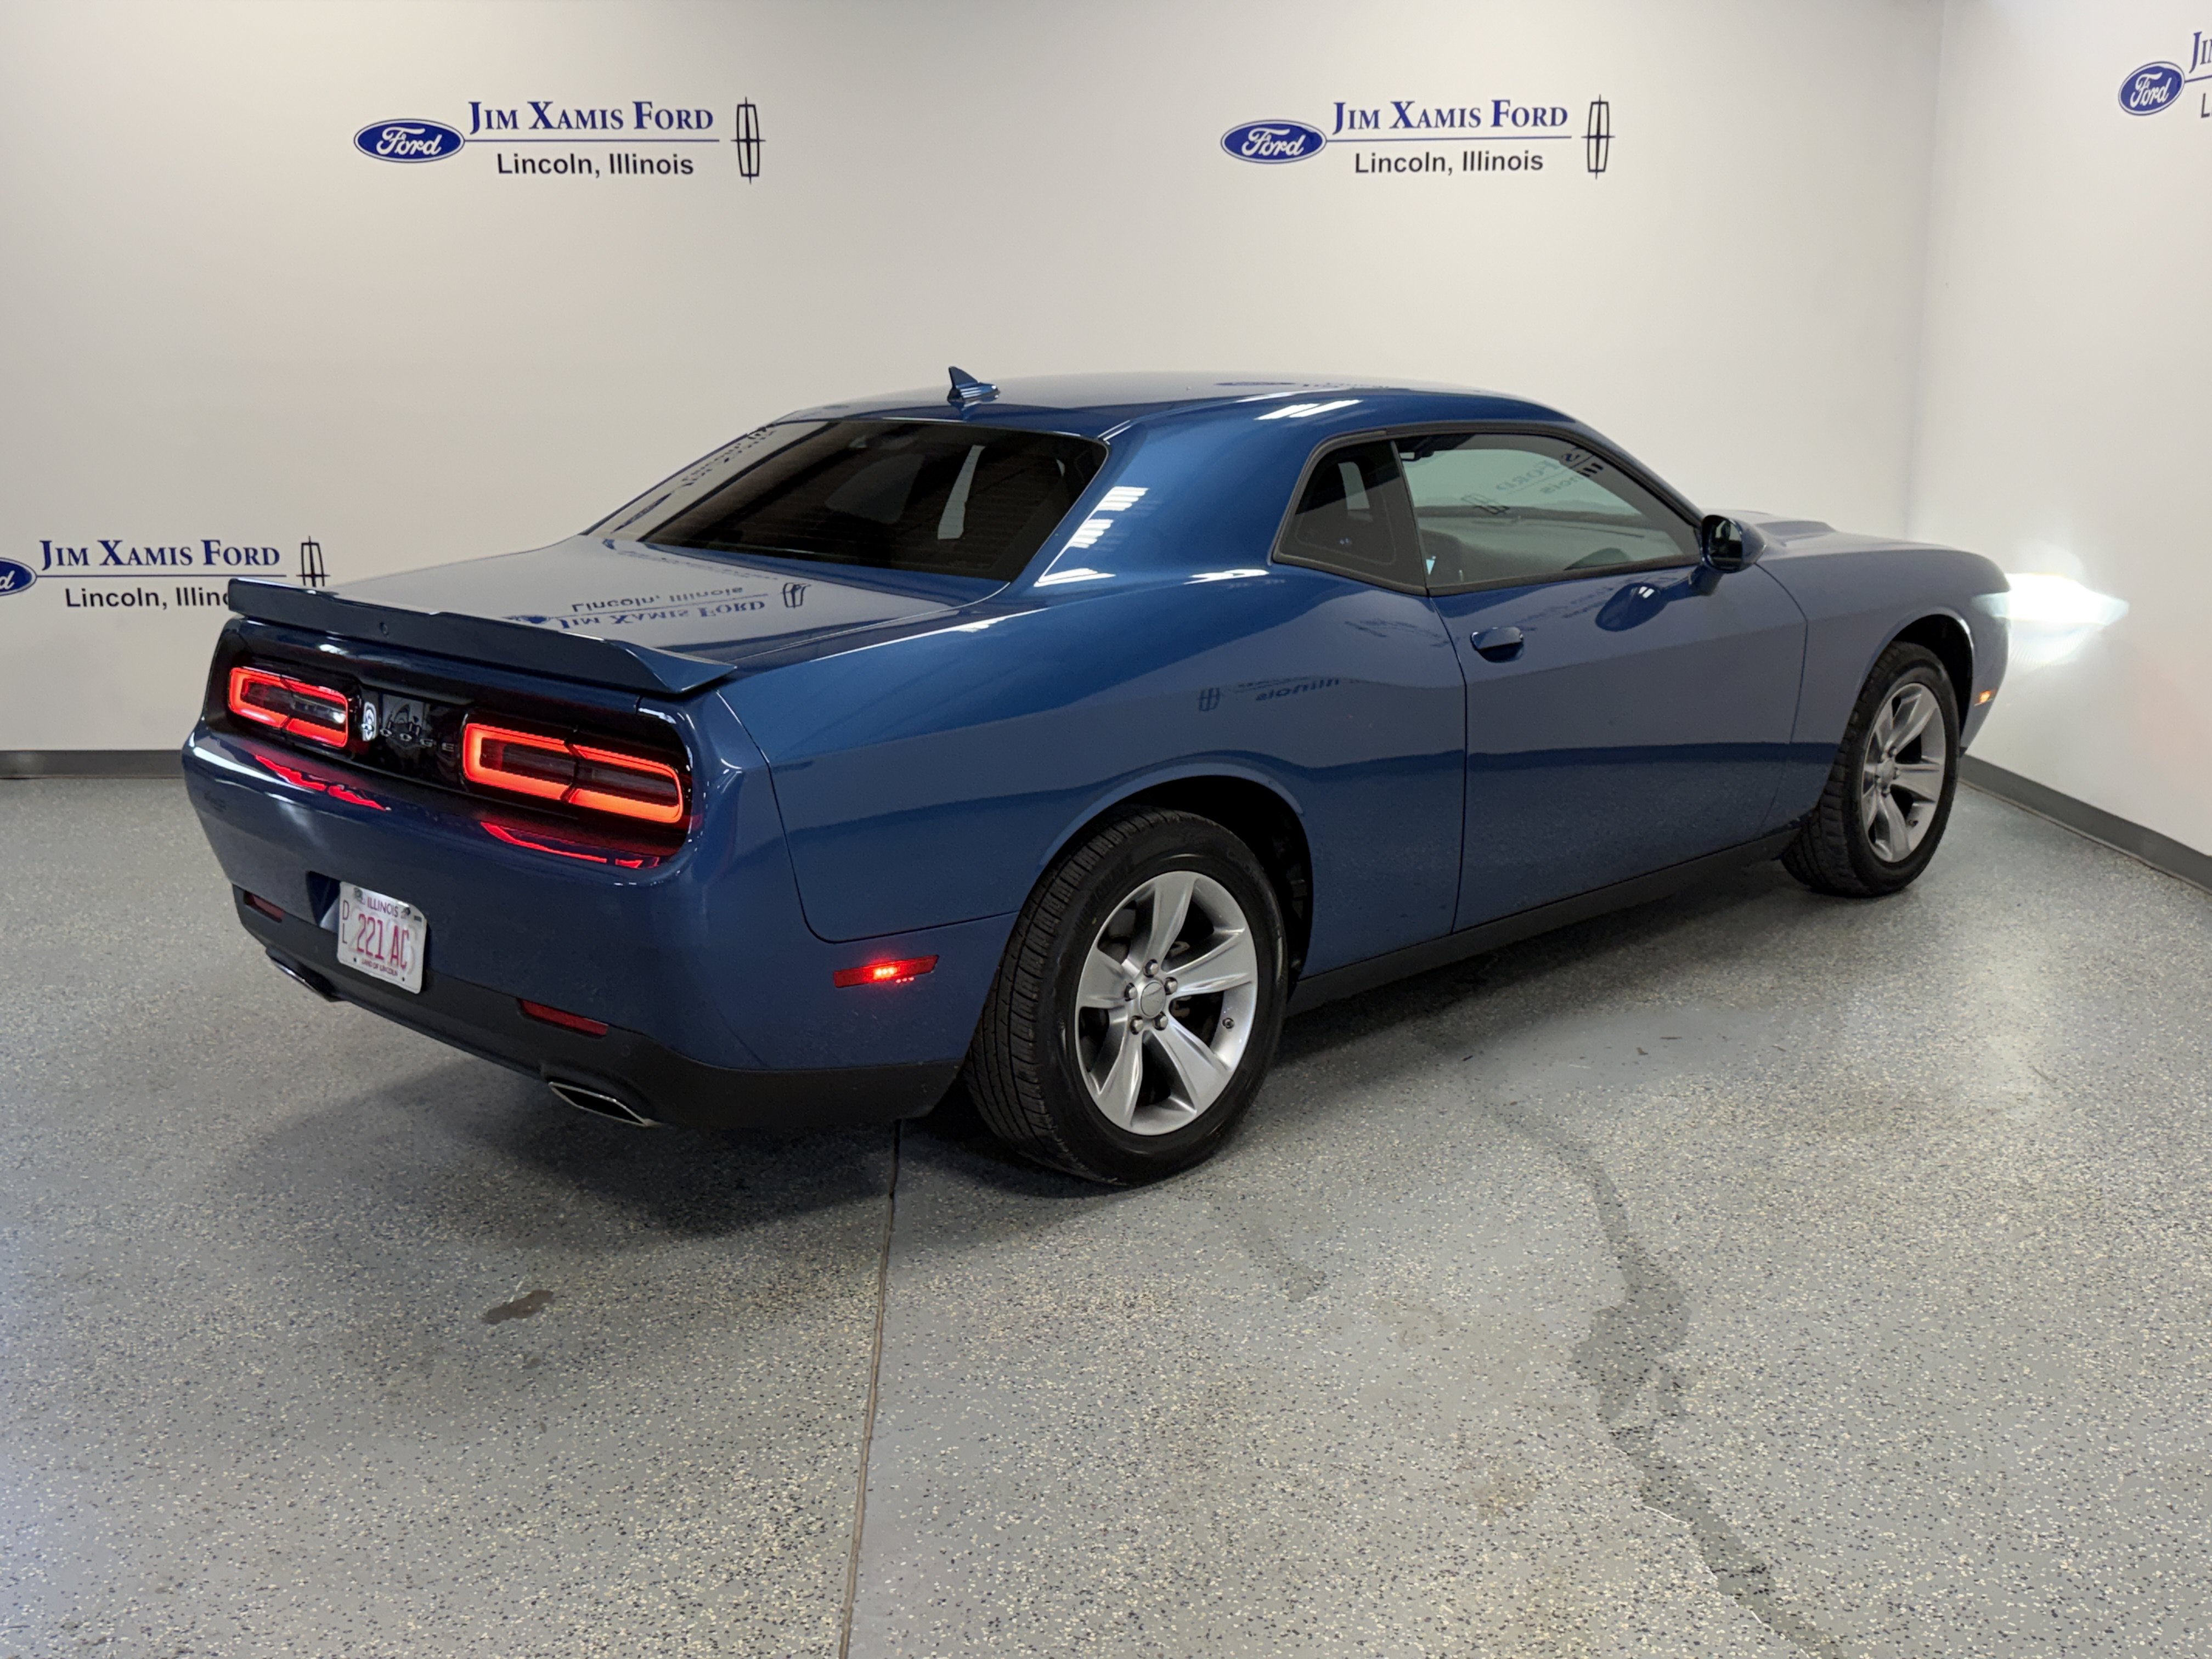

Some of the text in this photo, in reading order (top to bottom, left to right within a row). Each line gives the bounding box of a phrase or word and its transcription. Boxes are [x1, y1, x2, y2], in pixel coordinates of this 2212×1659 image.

[2189, 31, 2212, 74] JI
[2130, 72, 2172, 108] Ford
[468, 100, 713, 135] JIM XAMIS FORD
[1332, 99, 1568, 135] JIM XAMIS FORD
[376, 127, 442, 156] Ford
[1241, 128, 1306, 157] Ford
[496, 153, 694, 178] Lincoln, Illinois
[1355, 150, 1543, 176] Lincoln, Illinois
[39, 539, 280, 571] JIM XAMIS FORD
[65, 586, 229, 610] Lincoln, Illin
[367, 897, 398, 917] ILLINOIS
[357, 913, 409, 970] 221 AC
